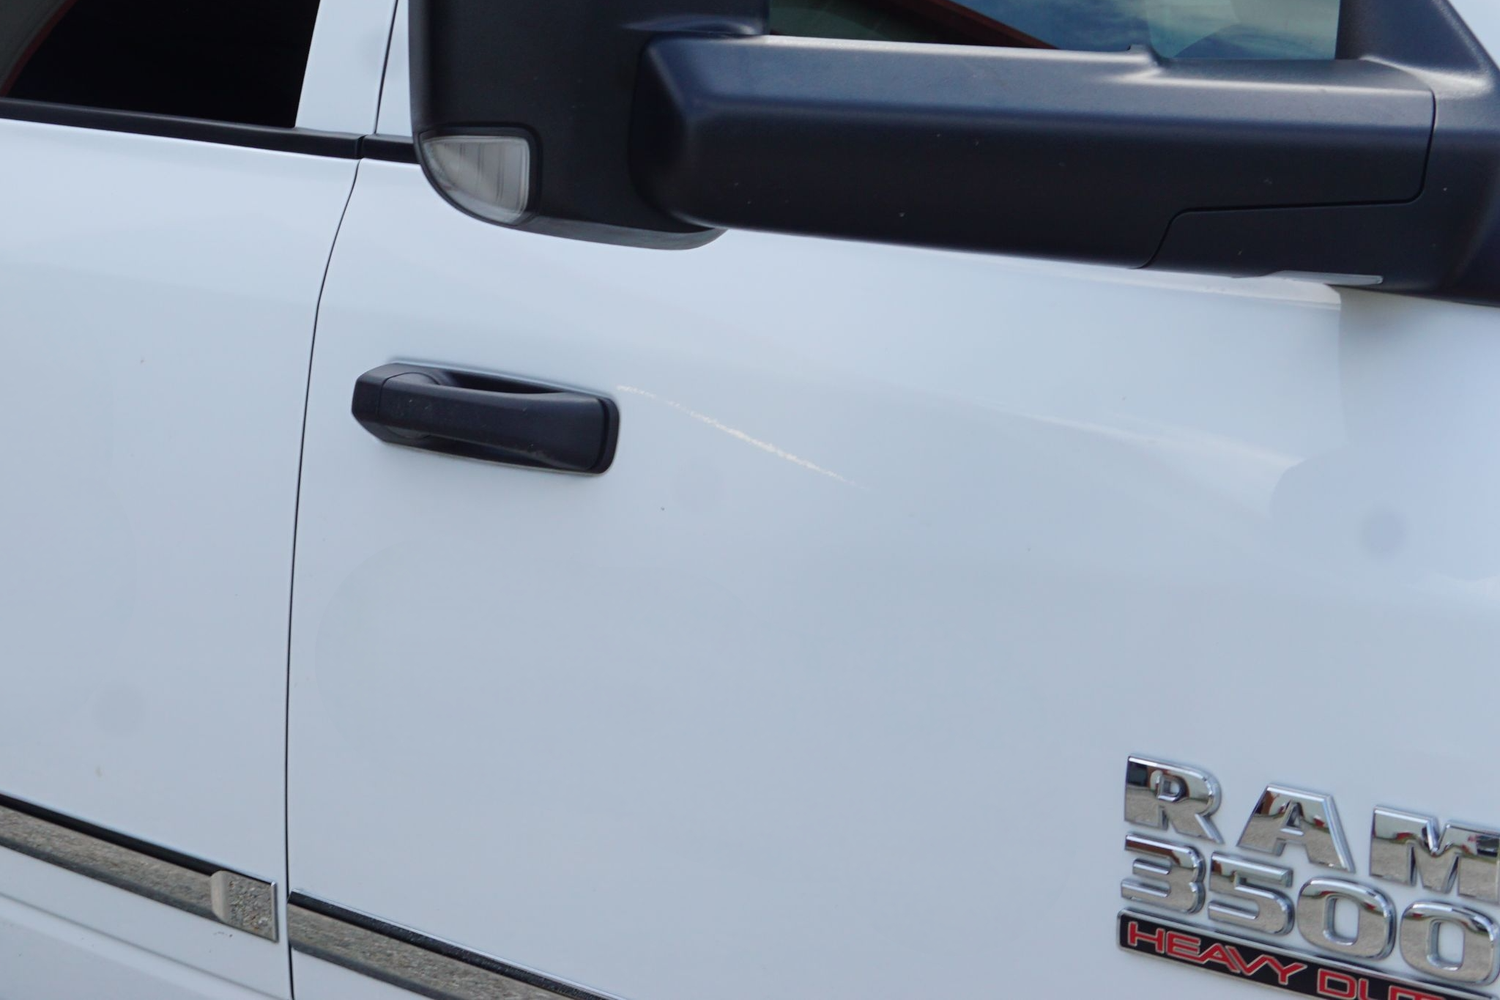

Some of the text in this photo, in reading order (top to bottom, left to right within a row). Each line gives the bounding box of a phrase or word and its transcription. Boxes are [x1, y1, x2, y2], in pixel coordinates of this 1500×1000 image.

[1123, 753, 1500, 908] RAM
[1120, 832, 1500, 987] 3500
[1127, 921, 1308, 986] HEAVY
